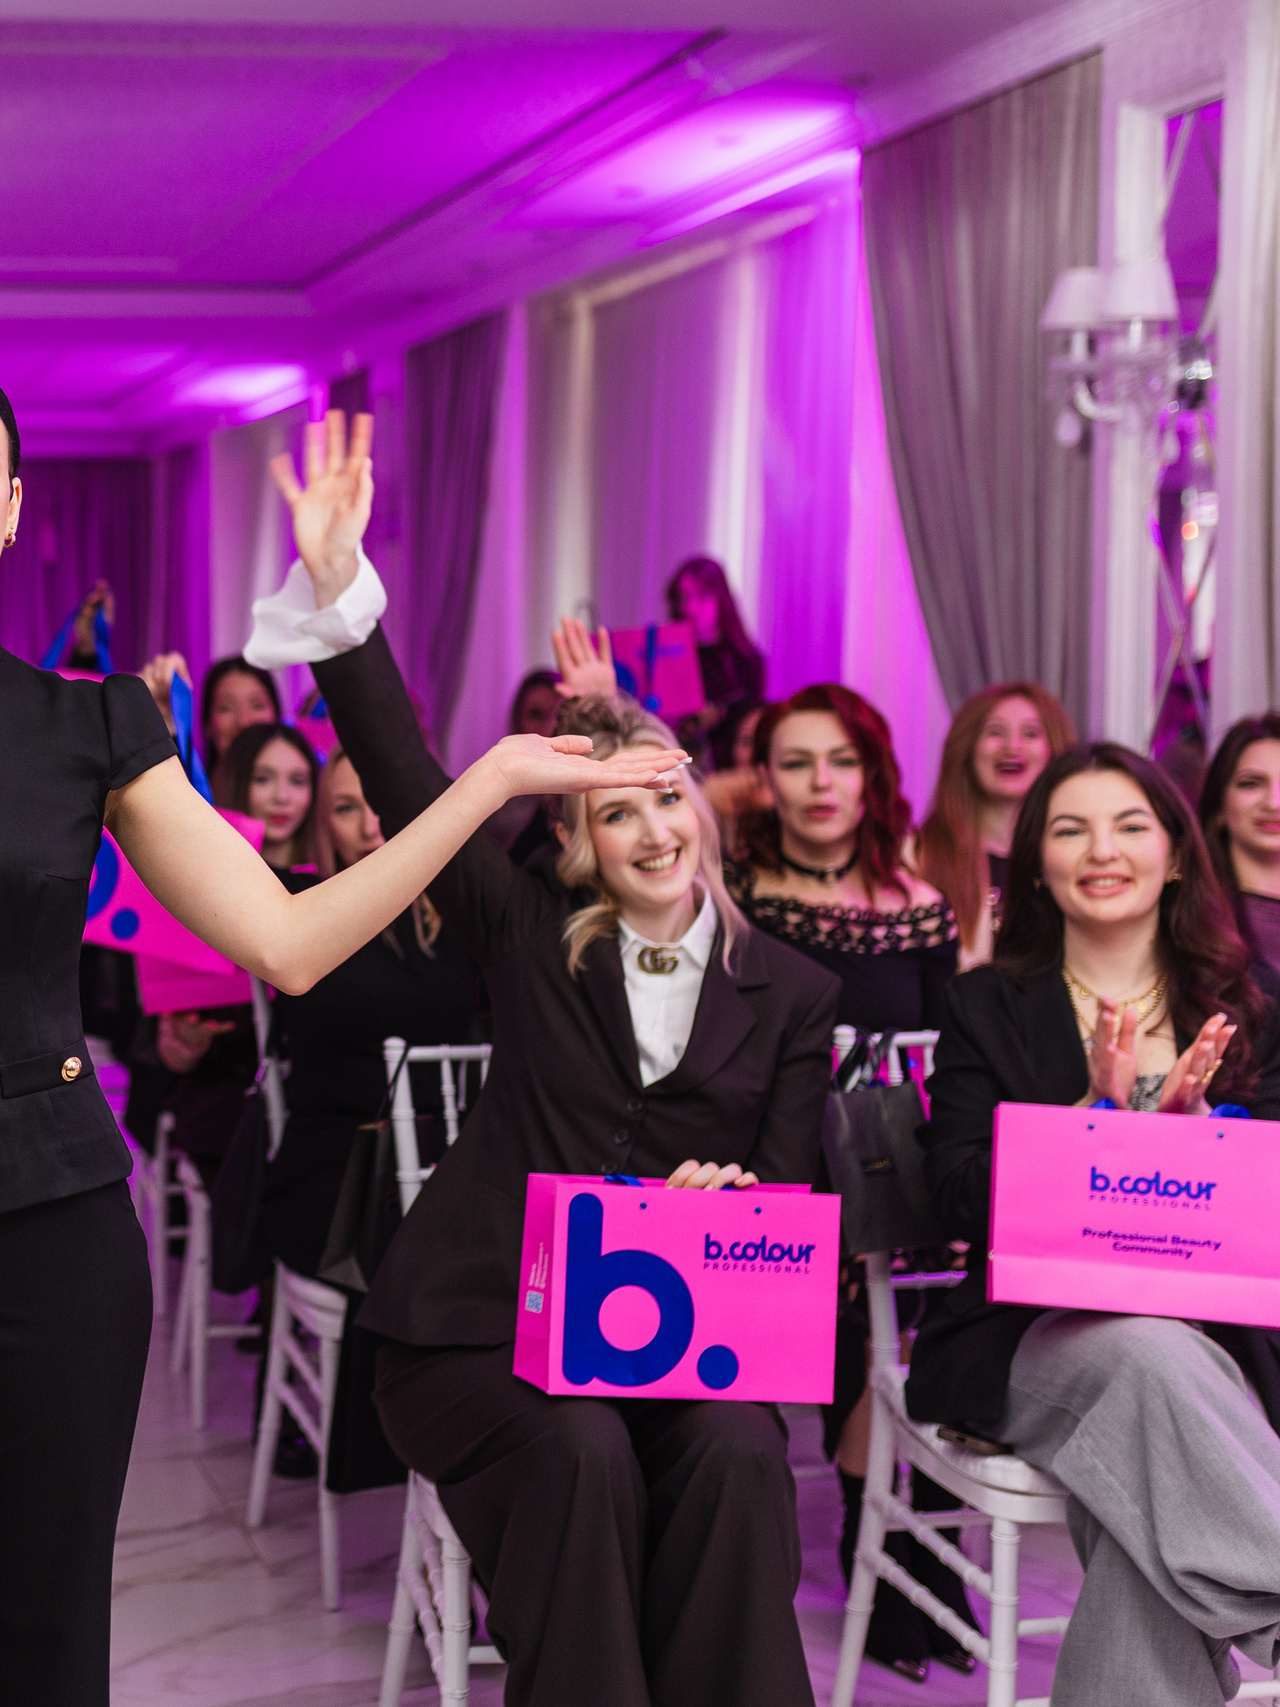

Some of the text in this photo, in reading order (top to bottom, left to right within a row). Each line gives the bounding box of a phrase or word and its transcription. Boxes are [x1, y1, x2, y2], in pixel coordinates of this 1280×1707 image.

[1091, 1166, 1217, 1200] b.colour
[704, 1233, 816, 1264] b.colour
[1082, 1227, 1221, 1251] Professional Beauty
[1113, 1241, 1193, 1260] Community
[703, 1262, 811, 1275] PROFESSIONAL
[563, 1193, 739, 1390] b.
